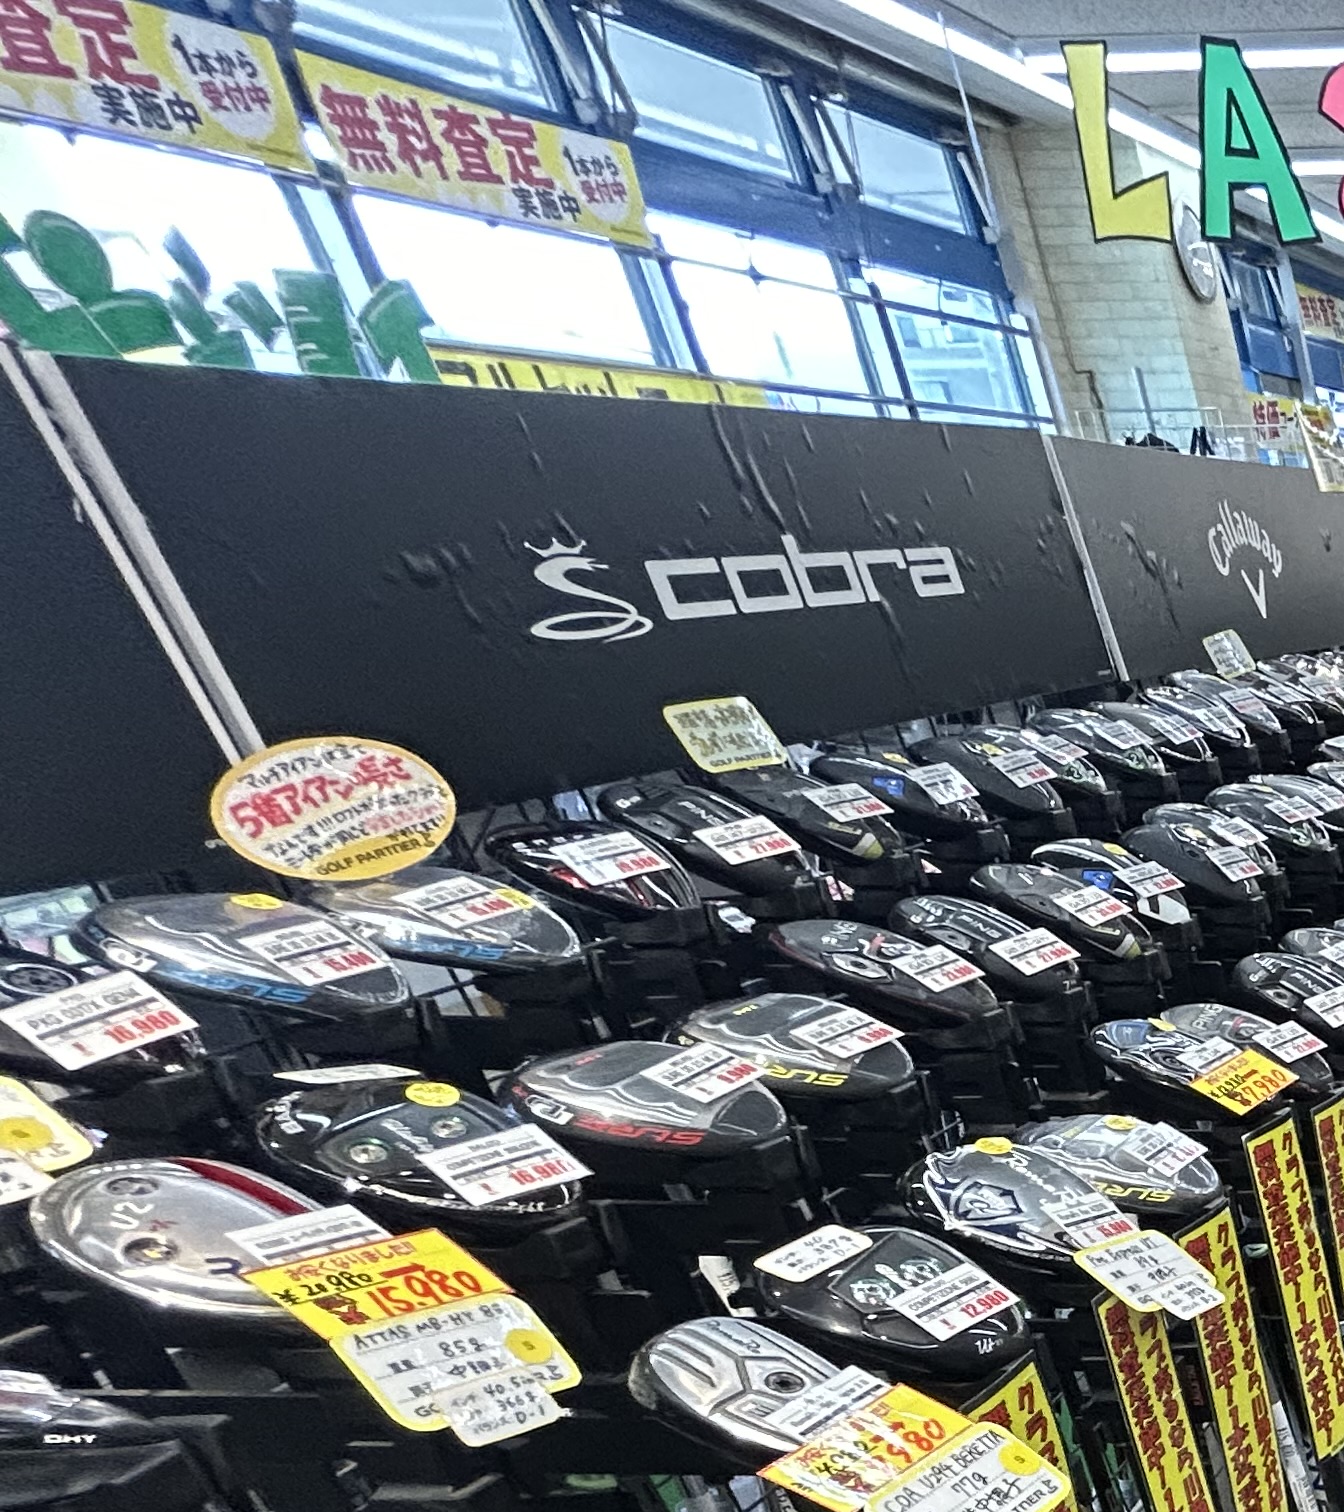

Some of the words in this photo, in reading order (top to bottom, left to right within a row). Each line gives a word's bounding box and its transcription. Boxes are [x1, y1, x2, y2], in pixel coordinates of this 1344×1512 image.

[171, 33, 258, 80] 1本から
[90, 82, 204, 135] 実施中
[199, 81, 272, 115] 受付中
[317, 83, 556, 190] 無料査定
[562, 144, 619, 179] 1本から
[510, 186, 581, 222] 実施中
[581, 175, 627, 204] 受付中
[1208, 498, 1283, 578] Callaway
[644, 534, 966, 621] cobra
[316, 859, 353, 876] GOLF
